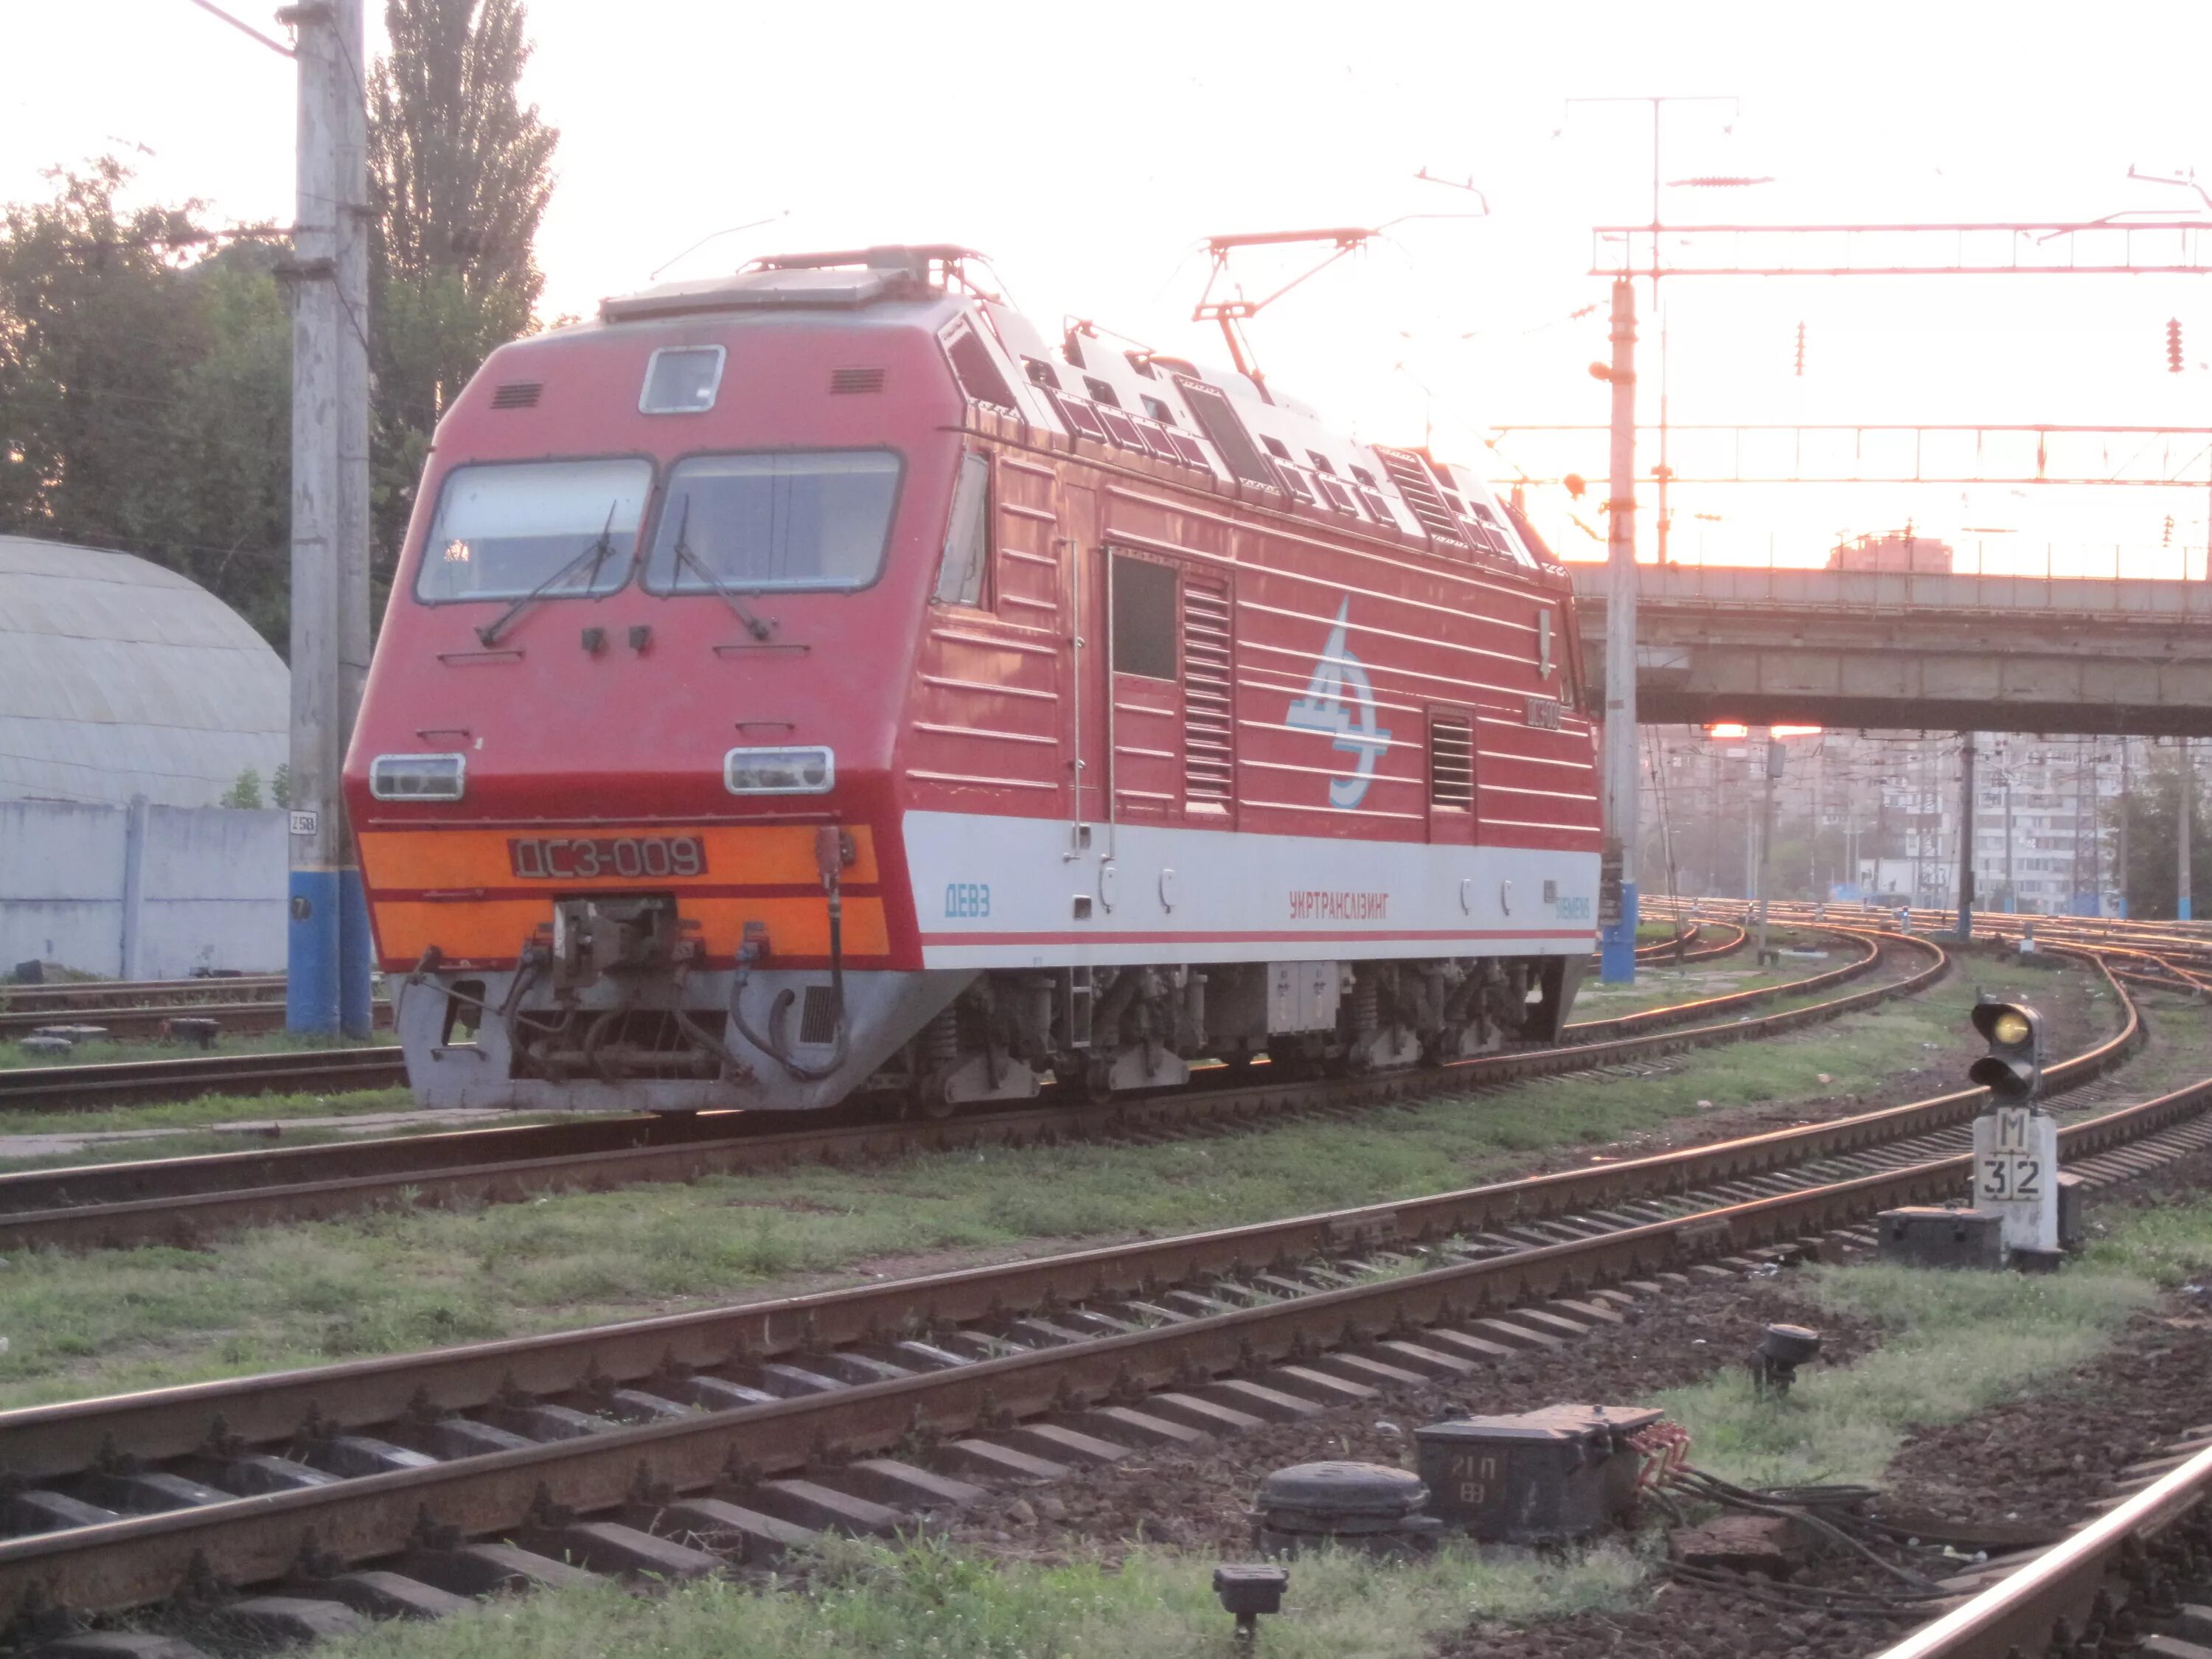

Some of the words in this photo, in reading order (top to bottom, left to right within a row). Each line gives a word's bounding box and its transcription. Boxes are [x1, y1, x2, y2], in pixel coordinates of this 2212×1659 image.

[515, 836, 700, 878] ДС3-009
[945, 883, 990, 918] ДЕВЗ
[1290, 891, 1389, 919] УКРТРАНСЛІЗИНГ
[1984, 1160, 2039, 1194] 32
